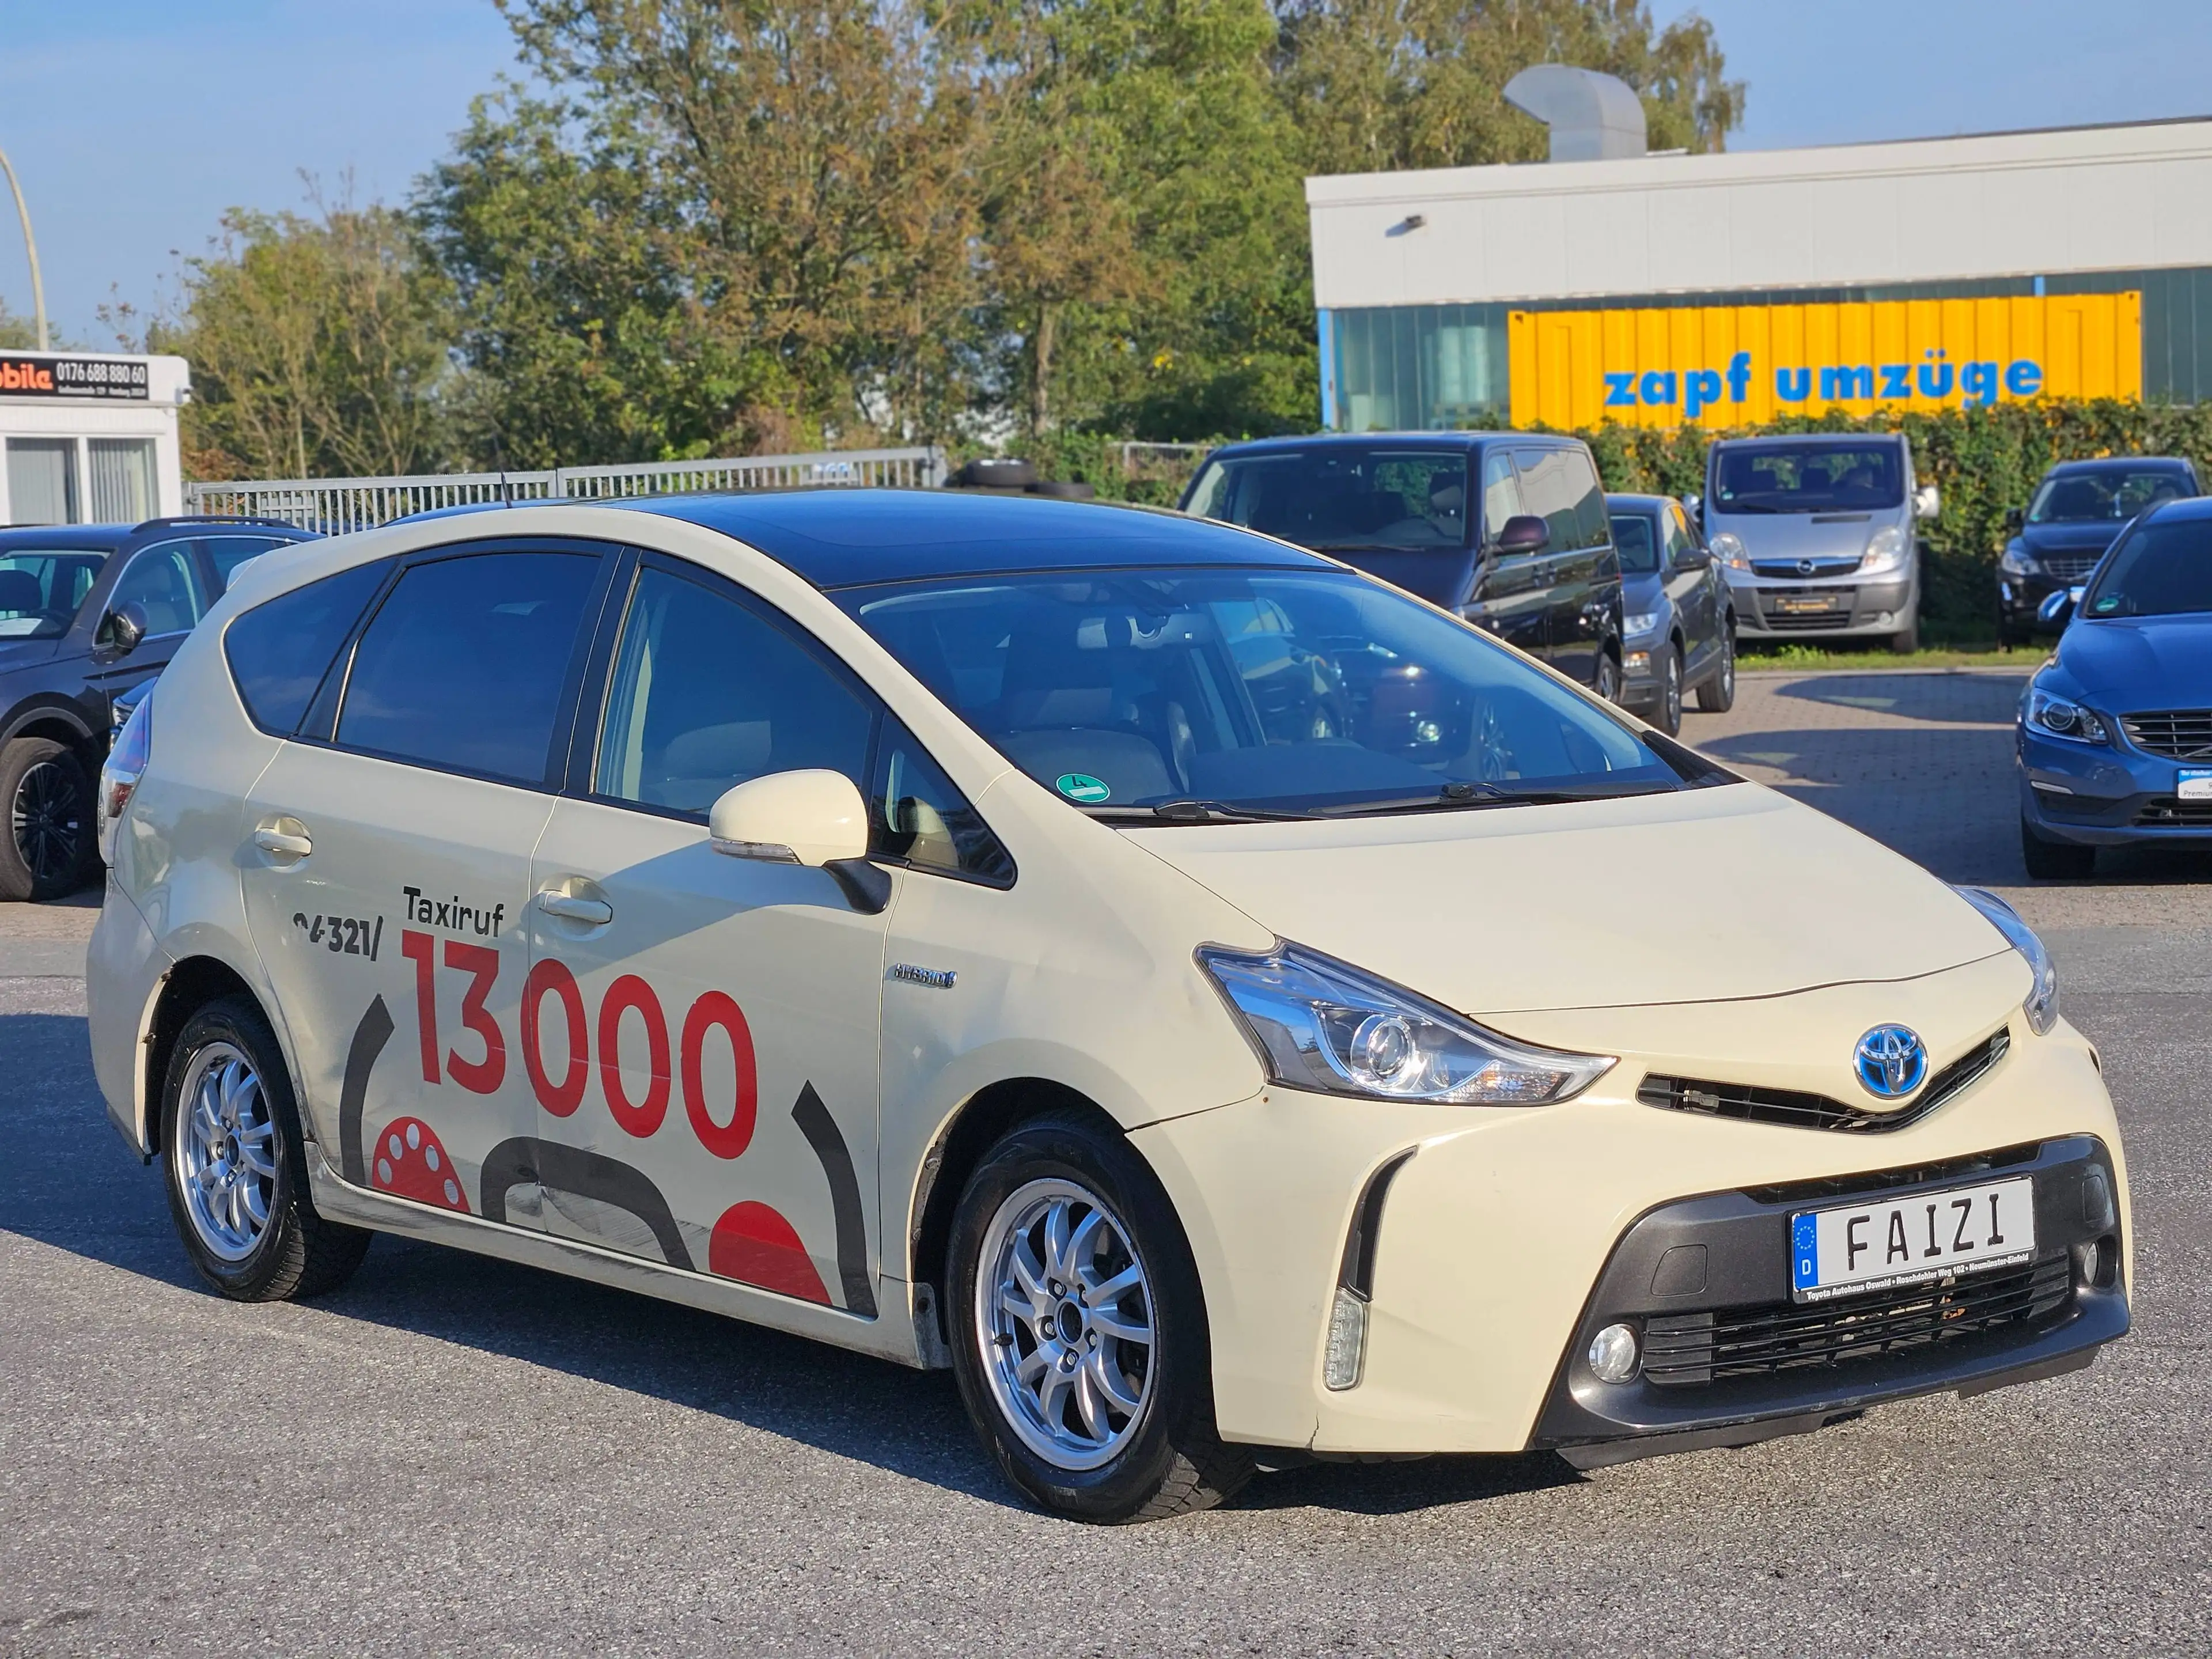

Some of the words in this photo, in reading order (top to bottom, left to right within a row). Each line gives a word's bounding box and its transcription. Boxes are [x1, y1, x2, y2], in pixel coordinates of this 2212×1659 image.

[0, 362, 54, 391] bile
[56, 362, 85, 381] 0176
[86, 363, 108, 382] 688
[109, 365, 130, 383] 880
[131, 366, 145, 384] 60
[1604, 351, 1751, 418] zapf
[1775, 348, 2043, 410] umzüge
[403, 886, 504, 937] Taxiruf
[402, 929, 757, 1160] 13000
[1847, 1193, 2004, 1271] FAIZI
[1801, 1259, 1812, 1275] D
[1806, 1289, 1831, 1301] Toyota
[1831, 1283, 1865, 1296] Autohaus
[1866, 1278, 1891, 1289] Oswald
[1896, 1271, 1937, 1285] Roschdohler
[1938, 1268, 1952, 1277] Weg
[1953, 1265, 1965, 1274] 102
[1969, 1252, 2029, 1271] Neumünster-Einfeld
